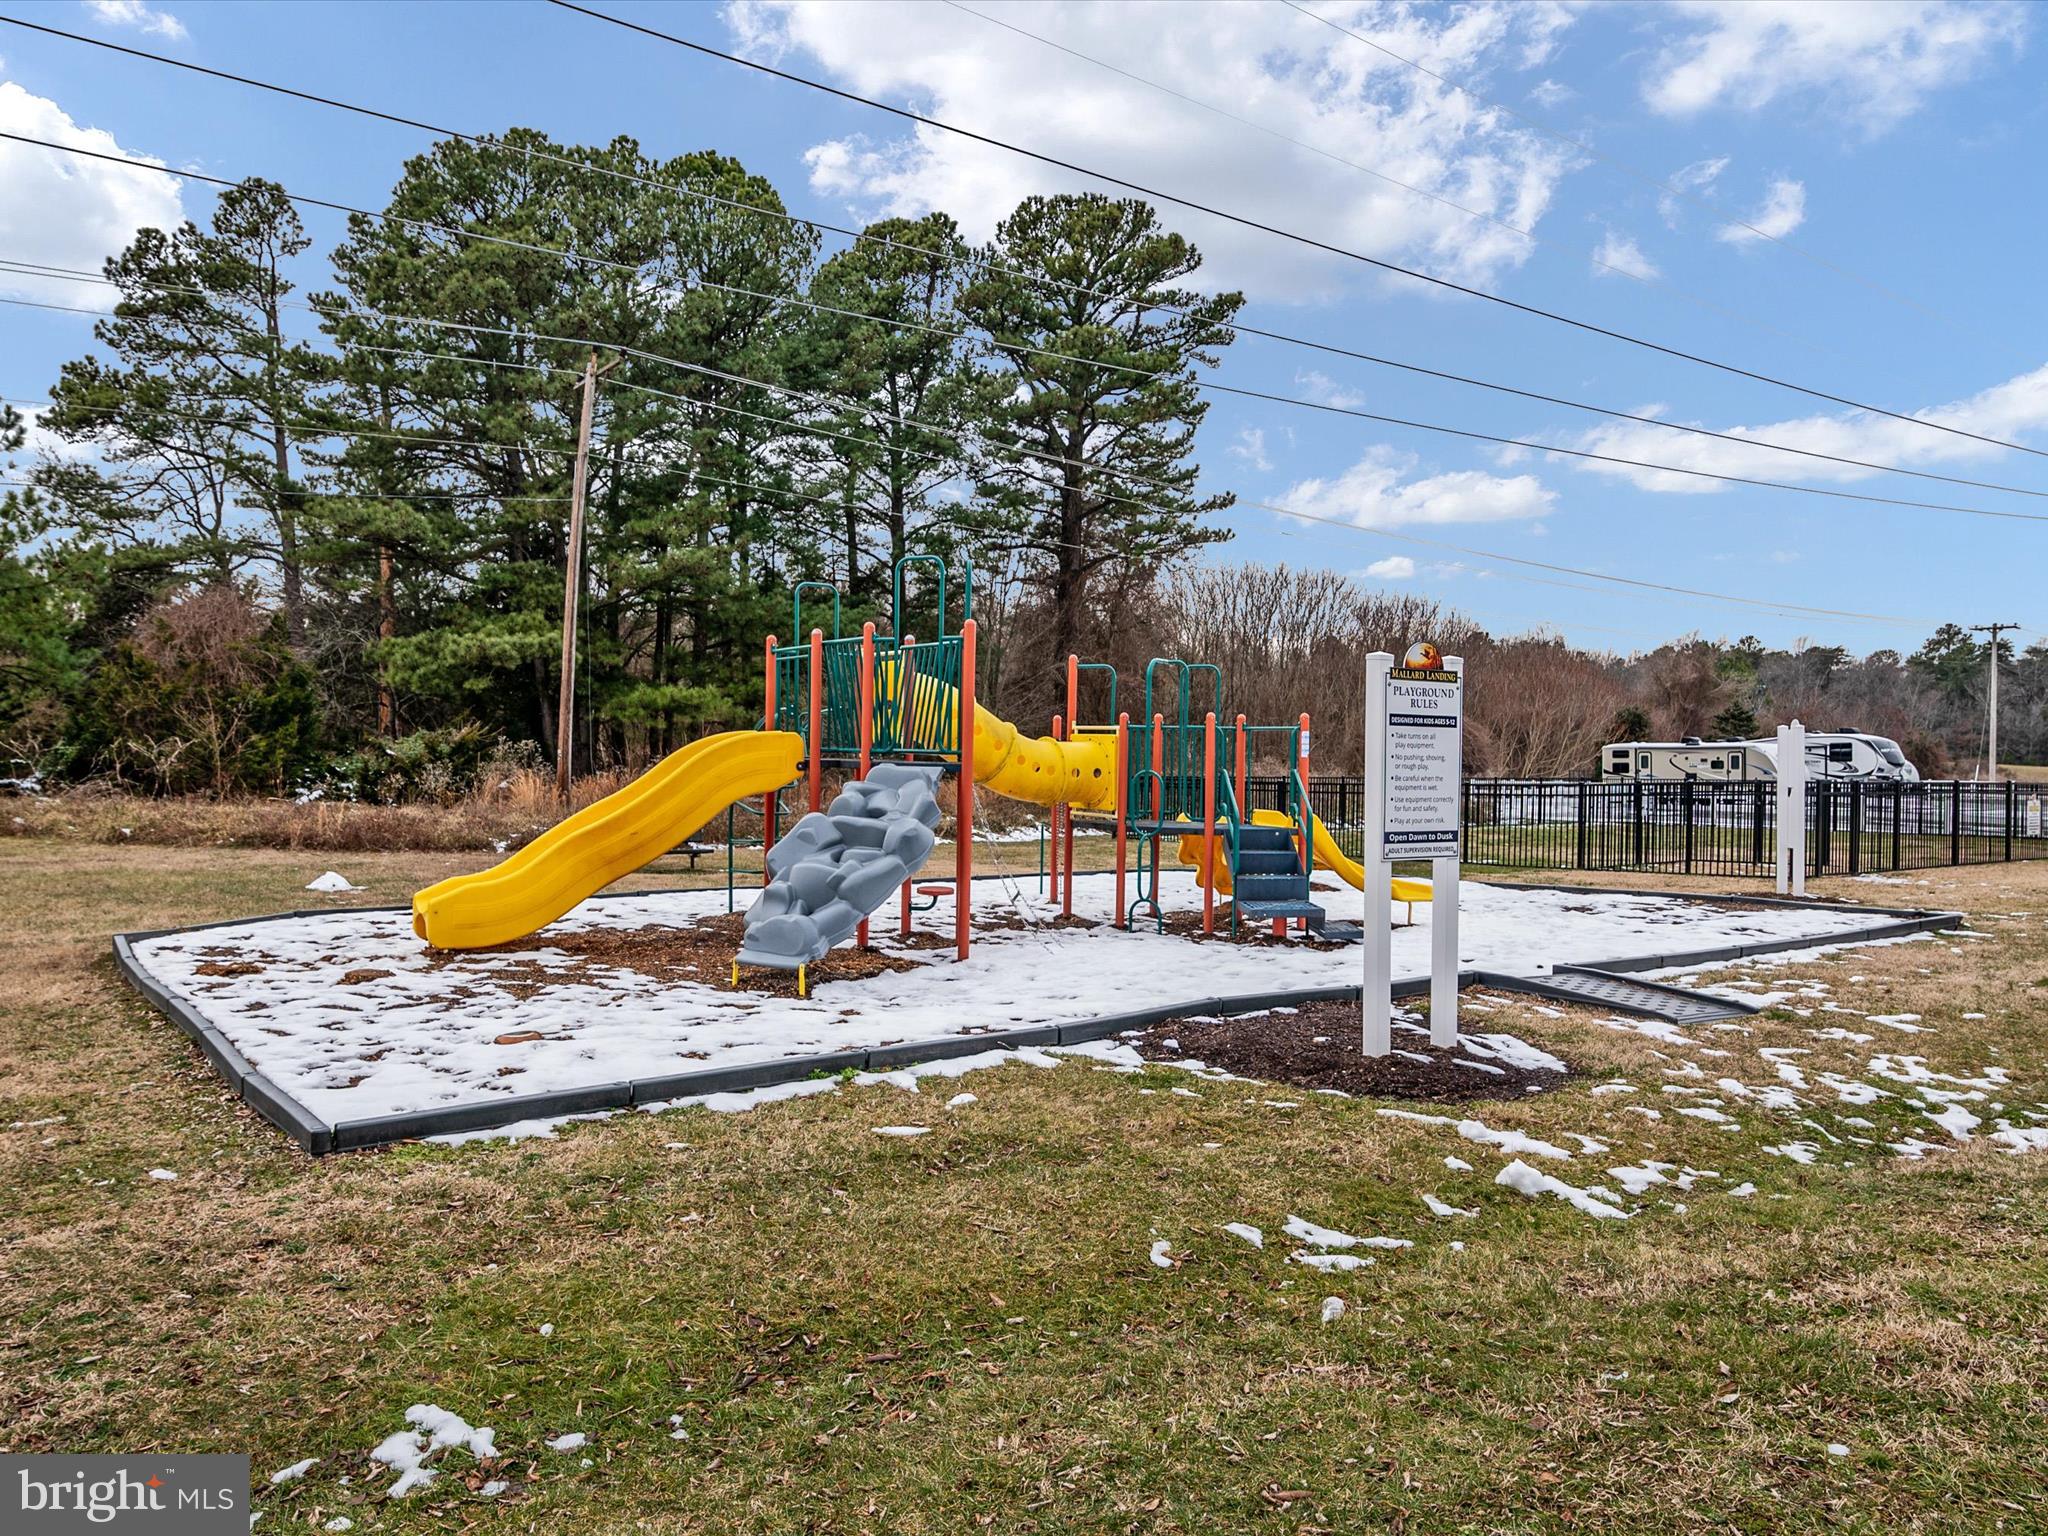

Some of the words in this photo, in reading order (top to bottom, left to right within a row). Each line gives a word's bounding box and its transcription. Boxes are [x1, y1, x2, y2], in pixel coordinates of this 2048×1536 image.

[1392, 669, 1425, 679] MALLARD
[1427, 671, 1456, 681] LANDING
[1393, 686, 1454, 698] PLAYGROUND
[1410, 698, 1438, 709] RULES
[1391, 716, 1413, 724] DESIGNED
[1446, 718, 1455, 726] 5-12
[1404, 754, 1425, 762] pushing,
[1389, 833, 1407, 843] Open
[1408, 833, 1427, 841] Dawn
[1437, 832, 1453, 840] Dusk
